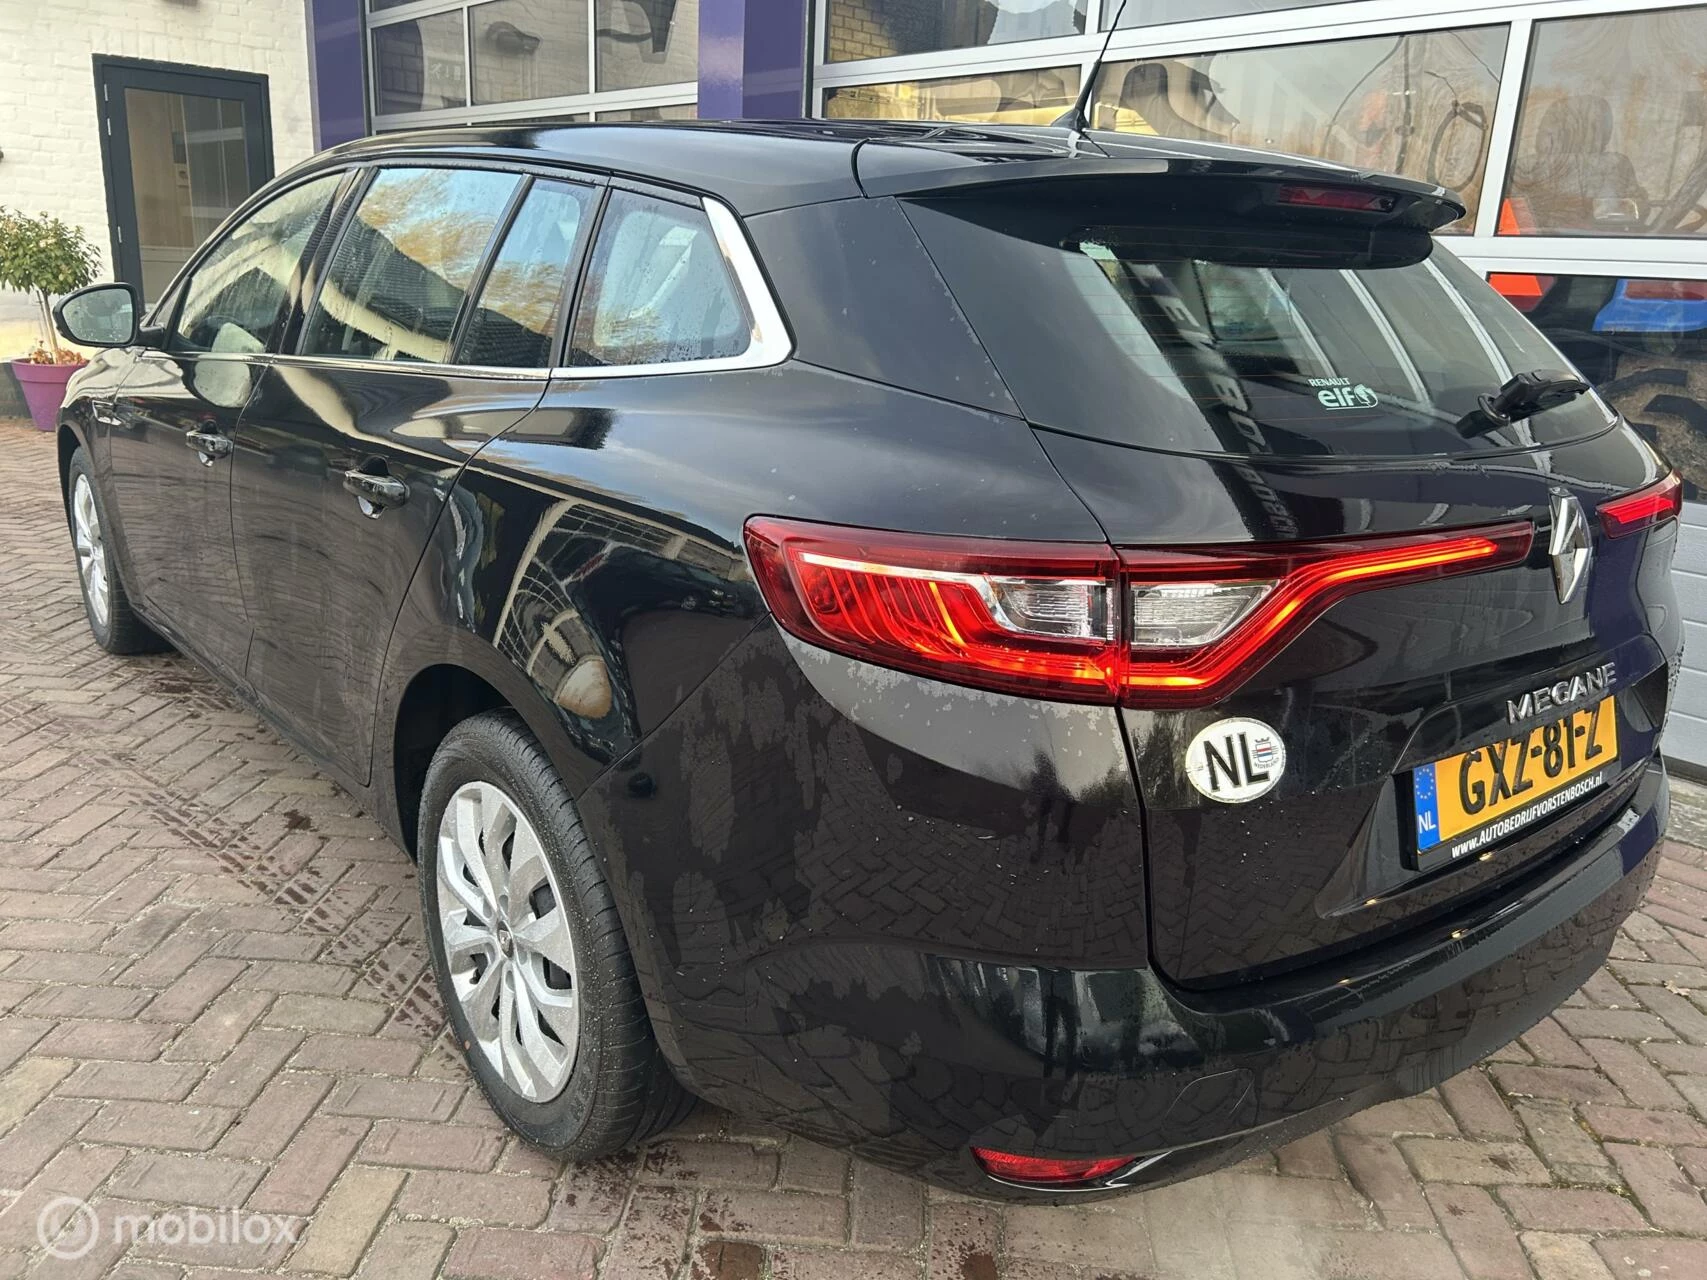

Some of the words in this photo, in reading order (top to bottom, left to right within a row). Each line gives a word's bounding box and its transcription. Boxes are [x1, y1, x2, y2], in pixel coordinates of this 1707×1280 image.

[1308, 378, 1351, 387] RENAULT
[1318, 387, 1355, 407] elf
[1507, 662, 1617, 724] MEGANE
[1203, 732, 1270, 792] NL
[1459, 702, 1603, 815] GXZ-81-Z
[1417, 811, 1436, 834] NL
